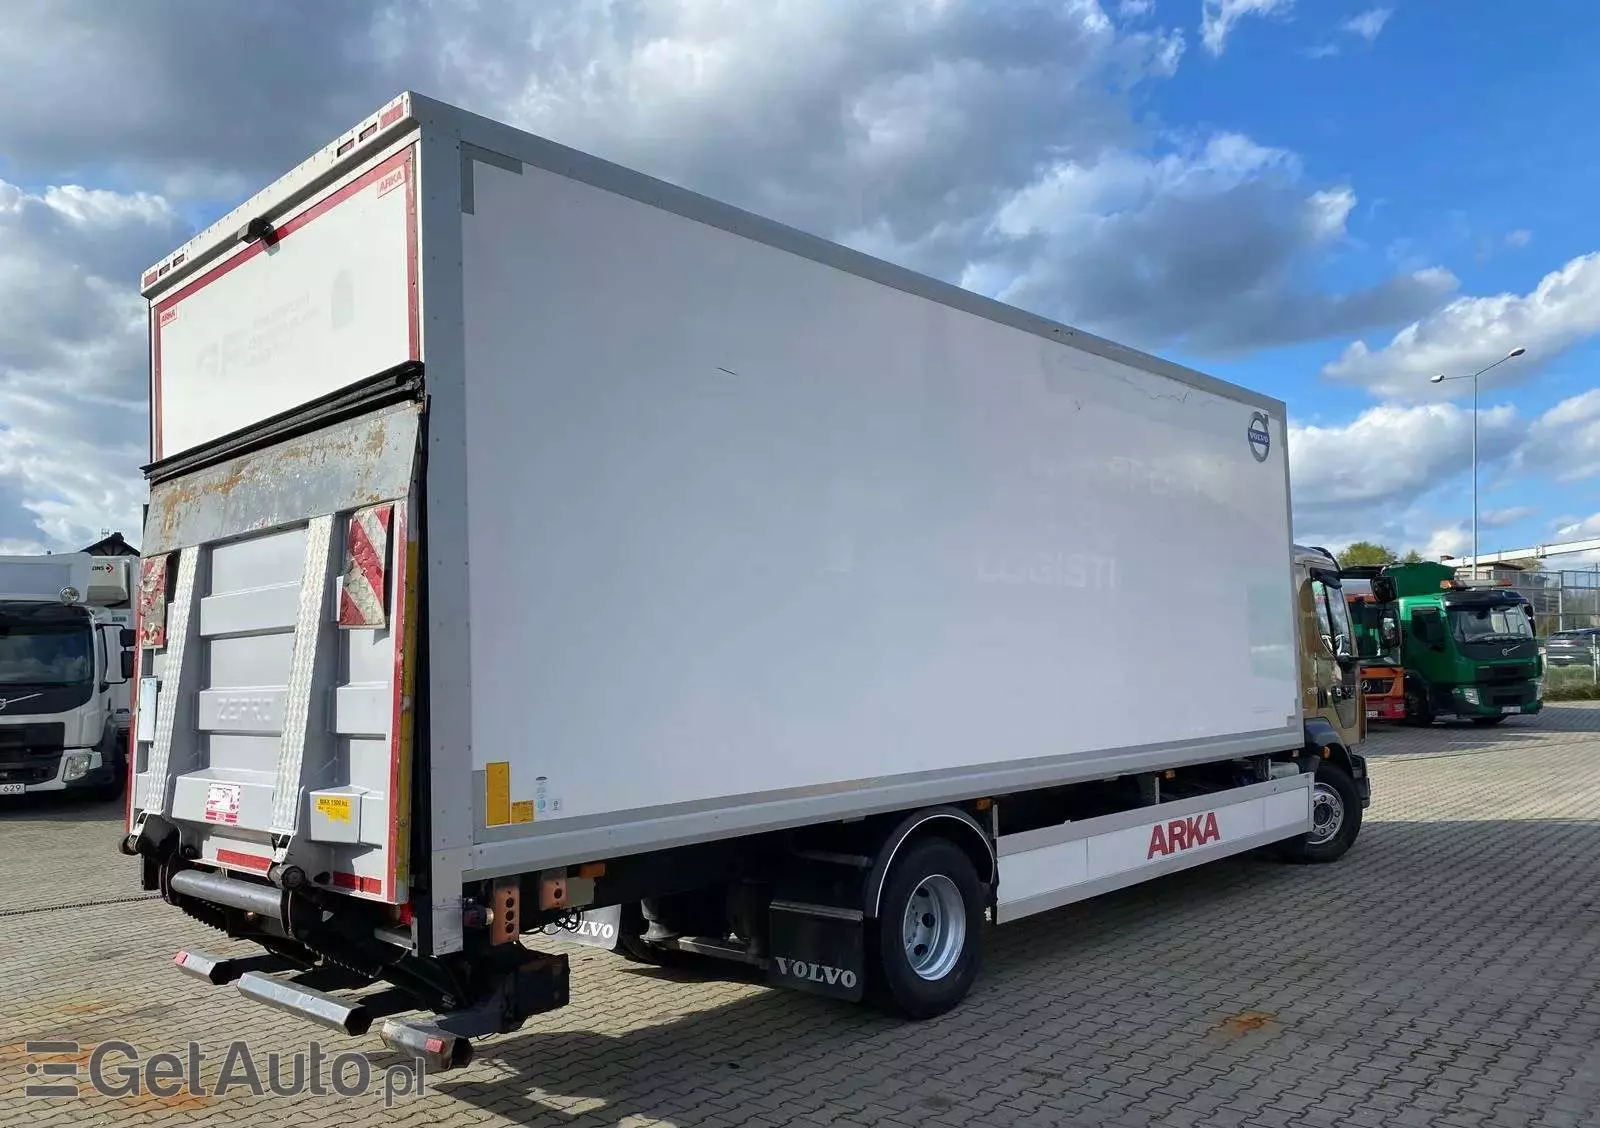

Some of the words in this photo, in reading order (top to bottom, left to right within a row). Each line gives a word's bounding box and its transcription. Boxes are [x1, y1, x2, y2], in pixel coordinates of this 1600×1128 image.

[379, 170, 403, 193] ARKA
[161, 309, 176, 323] ARKA
[1249, 431, 1269, 443] VOLVO
[1146, 811, 1221, 860] ARKA
[774, 956, 857, 989] VOLVO
